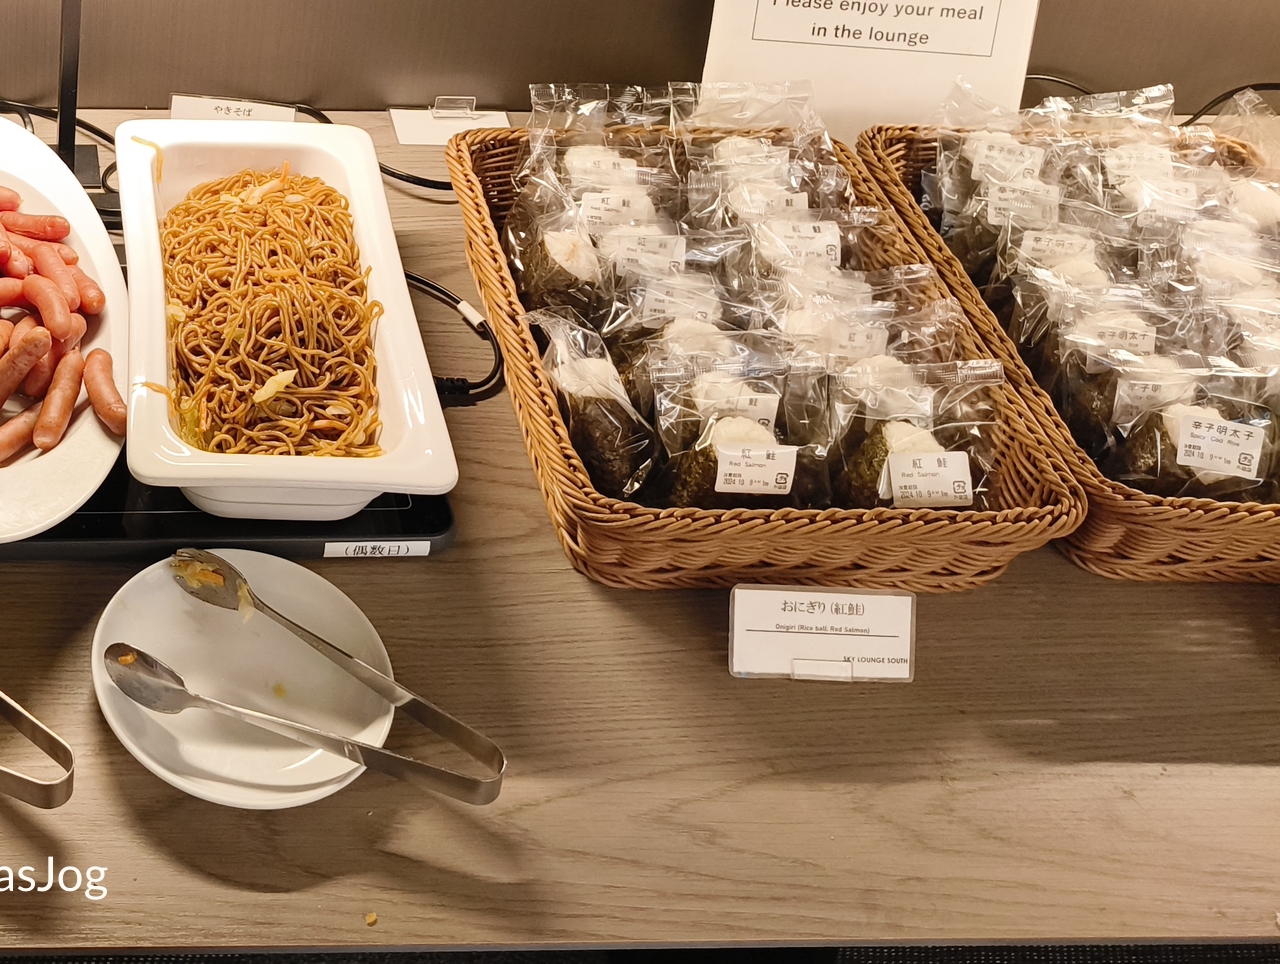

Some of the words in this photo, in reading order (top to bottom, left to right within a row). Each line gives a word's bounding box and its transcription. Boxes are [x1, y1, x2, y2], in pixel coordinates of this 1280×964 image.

[894, 4, 934, 18] your
[940, 6, 984, 20] meal
[811, 22, 828, 37] in
[834, 24, 862, 40] the
[869, 26, 930, 48] lounge
[213, 105, 253, 117] やきそば
[1192, 421, 1254, 441] 辛子明太子
[344, 544, 410, 556] （偶数日）
[781, 599, 866, 616] おにぎり（紅鮭）
[776, 623, 796, 632] Onigiri
[798, 624, 814, 632] (Rice
[844, 626, 870, 634] Salmon)
[858, 656, 885, 664] LOUNGE
